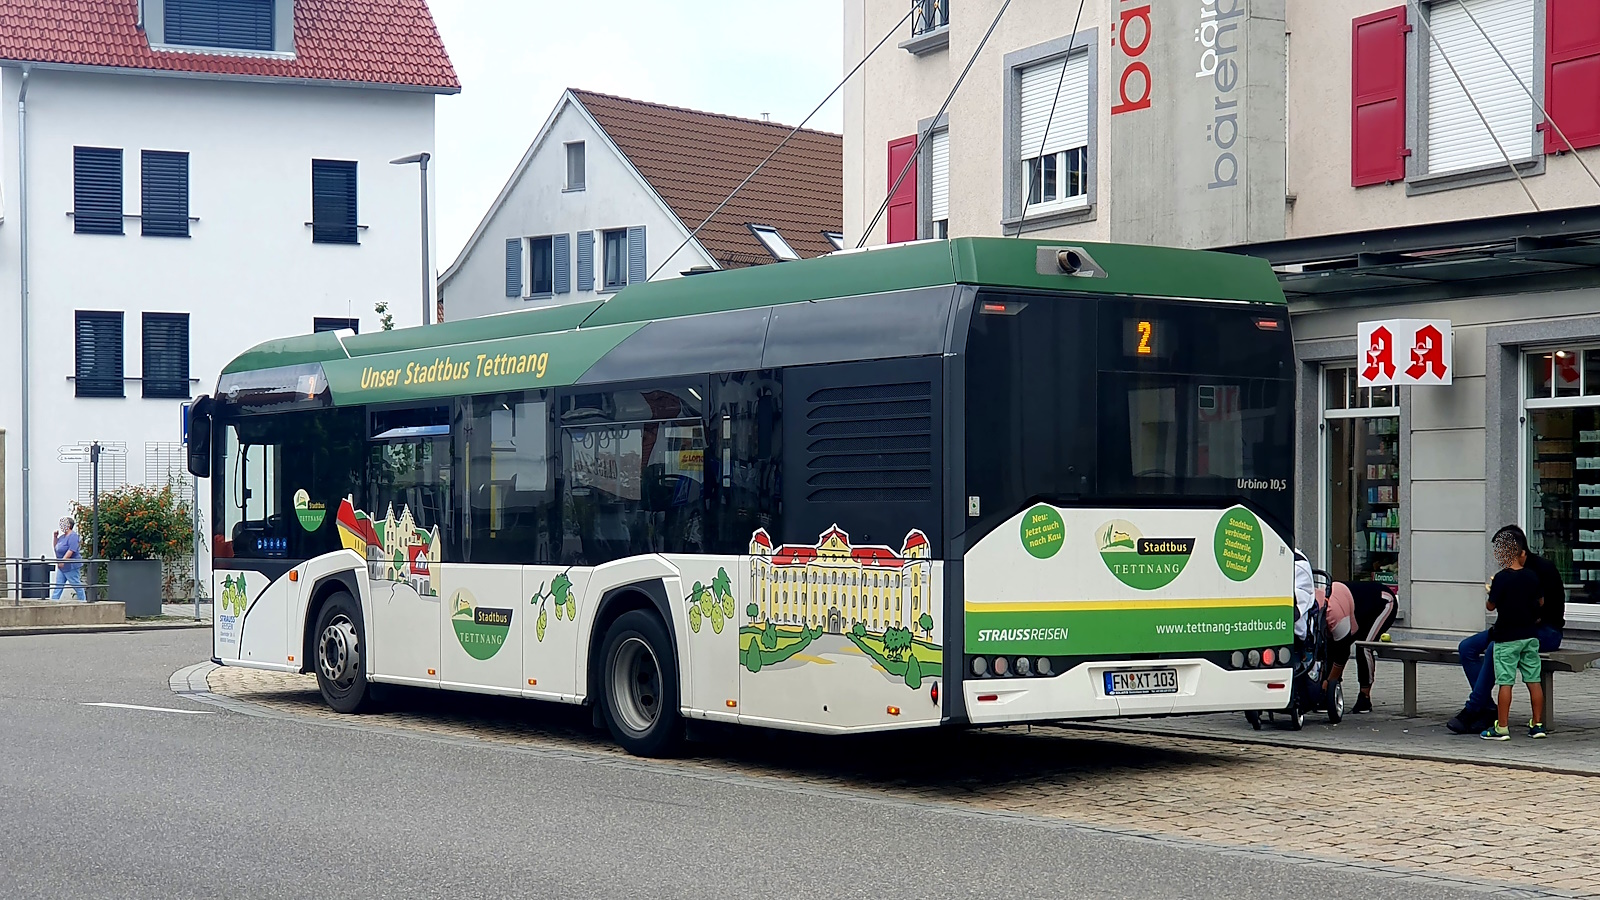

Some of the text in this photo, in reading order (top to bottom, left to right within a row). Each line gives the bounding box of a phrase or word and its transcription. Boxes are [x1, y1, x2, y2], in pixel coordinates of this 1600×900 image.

[1111, 0, 1151, 115] bä
[1137, 321, 1151, 353] 2
[360, 352, 549, 389] Unser Stadtbus Tettnang
[1237, 478, 1287, 491] Urbino 10,5
[1032, 514, 1048, 524] Neu:
[1229, 518, 1253, 531] Stadtbus
[1042, 521, 1059, 532] auch
[1029, 533, 1062, 547] nach Kau
[1144, 541, 1187, 552] Stadtbus
[1222, 548, 1247, 563] Bahnhof
[1114, 563, 1179, 574] TETTNANG
[1226, 560, 1248, 573] Umland
[478, 611, 508, 623] Stadtbus
[1156, 618, 1287, 635] www.tettnang-stadtbus.de
[460, 632, 502, 644] TETTNANG
[1153, 672, 1175, 687] 103
